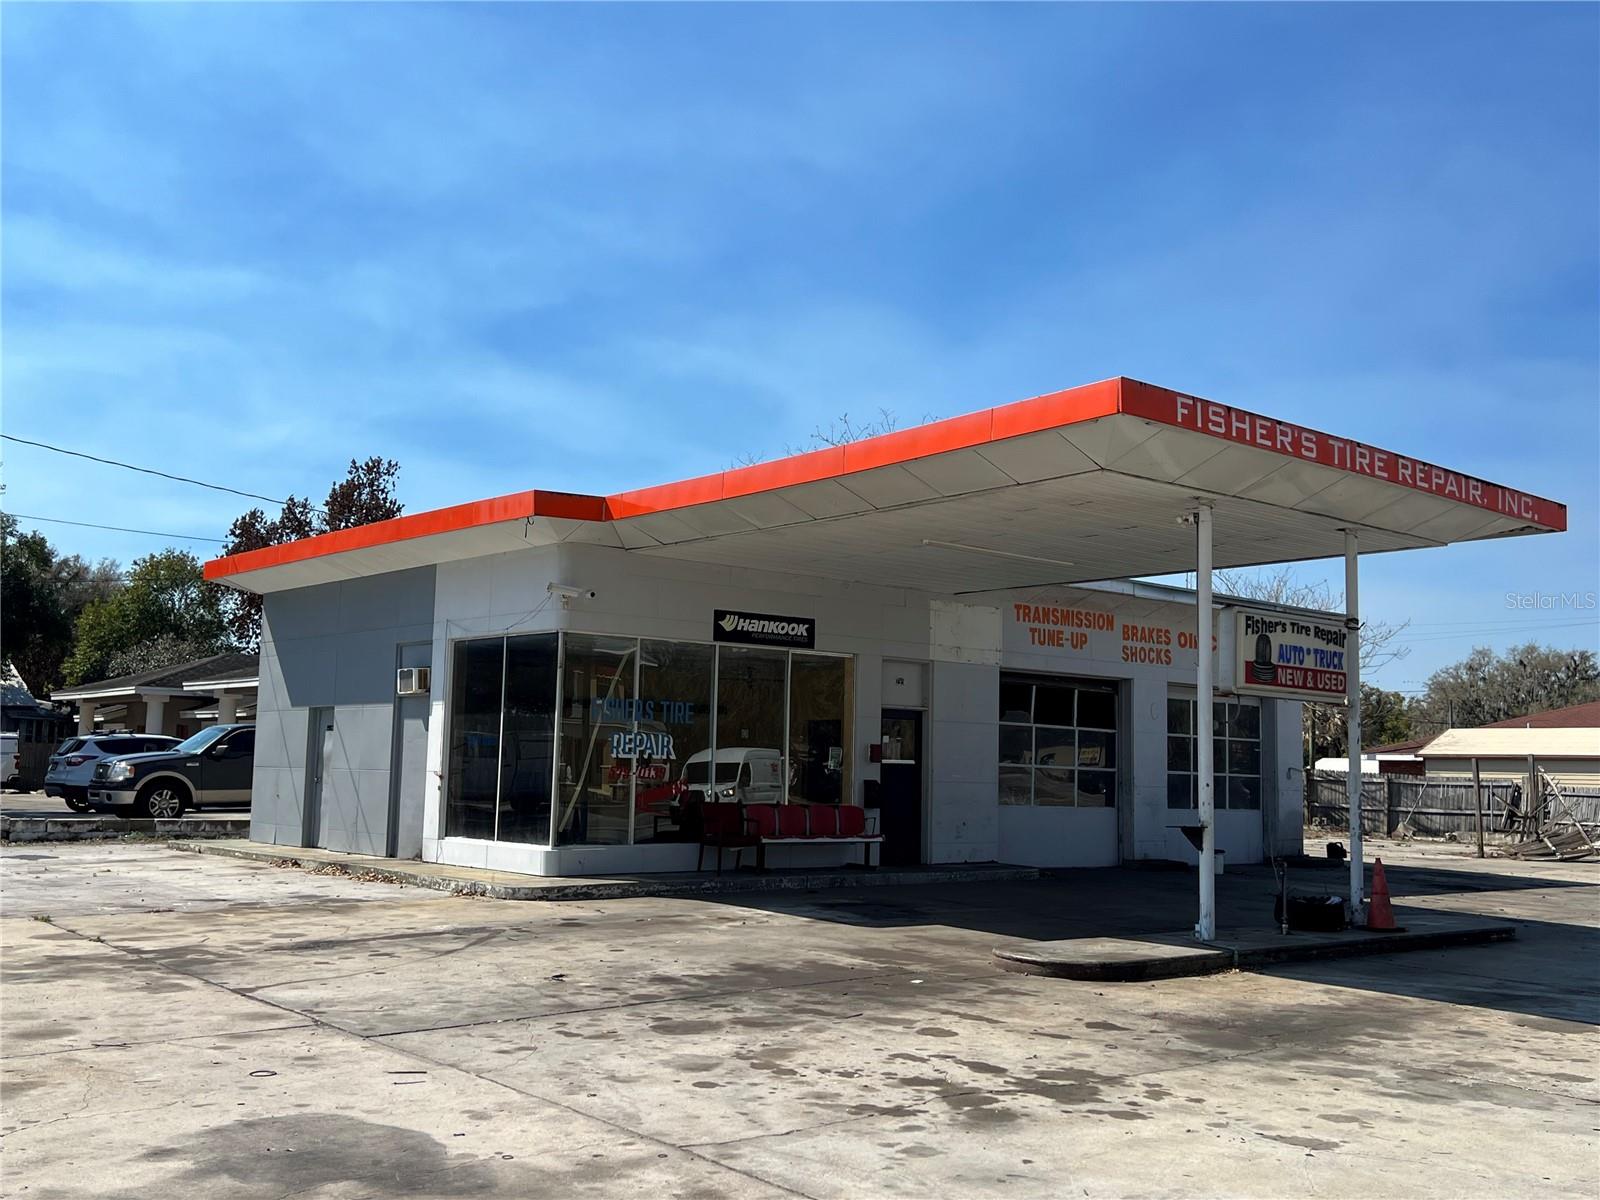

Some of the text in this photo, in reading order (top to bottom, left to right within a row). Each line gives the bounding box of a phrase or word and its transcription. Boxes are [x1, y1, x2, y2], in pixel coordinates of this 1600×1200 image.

[1176, 396, 1539, 521] FISHER'S TIRE REPAIR, INC.
[1014, 603, 1115, 632] TRANSMISSION
[1029, 627, 1088, 650] TUNE-UP
[1121, 624, 1172, 646] BRAKES
[1245, 615, 1346, 649] Fisher's Tire Repair
[1121, 645, 1172, 666] SHOCKS
[1277, 643, 1344, 671] AUTO TRUCK
[1277, 668, 1345, 691] NEW & USED
[660, 700, 696, 725] TIRE
[610, 732, 676, 760] REPAIR
